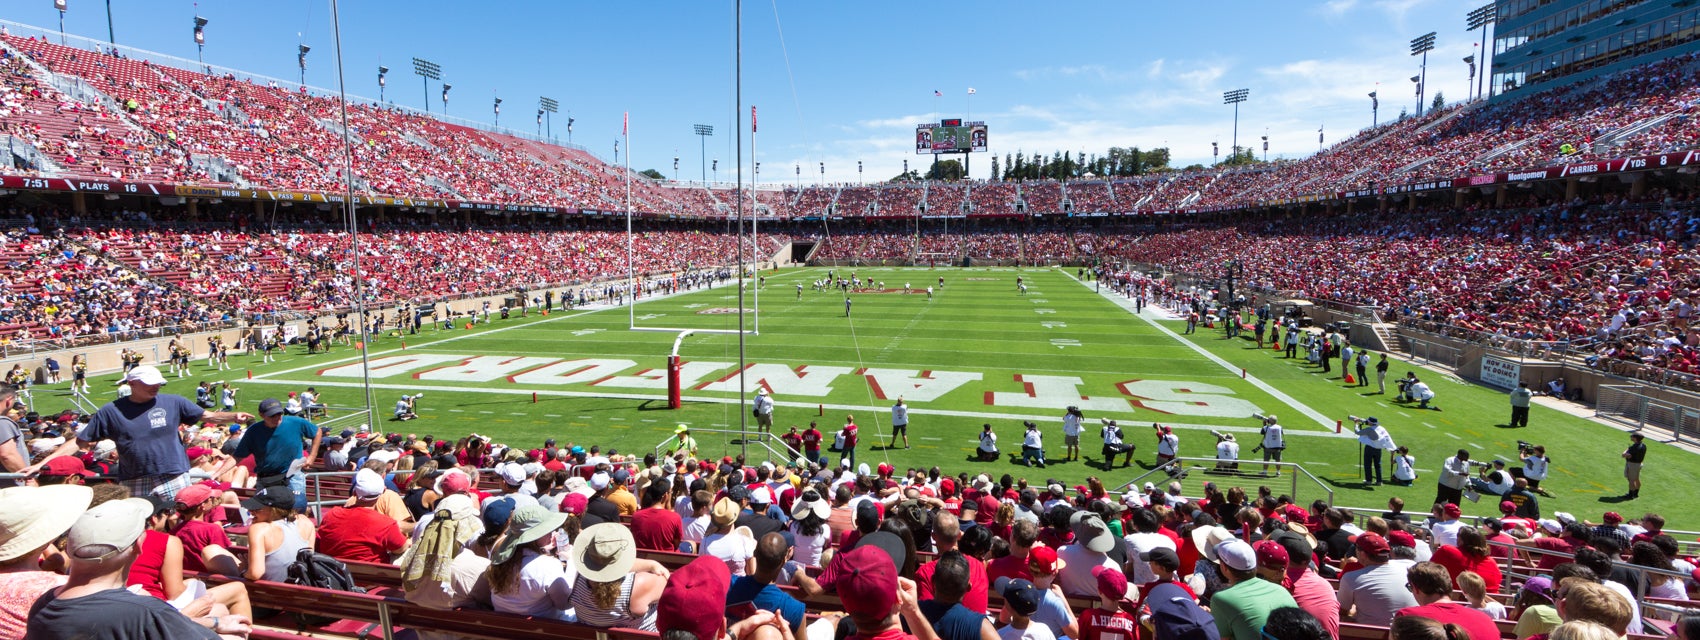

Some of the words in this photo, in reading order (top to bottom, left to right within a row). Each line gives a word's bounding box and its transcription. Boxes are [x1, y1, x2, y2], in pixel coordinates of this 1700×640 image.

[1569, 164, 1598, 174] CARRIES
[1606, 162, 1611, 171] 1
[1630, 159, 1646, 168] YDS
[1660, 155, 1667, 165] 8
[1507, 171, 1547, 181] Montgomery
[23, 178, 49, 188] 7:51
[79, 181, 109, 191] PLAYS
[124, 184, 137, 192] 16
[221, 189, 240, 197] RUSH
[1483, 364, 1491, 372] WE
[1492, 367, 1517, 379] DOING?
[1486, 359, 1500, 367] HOW
[1502, 362, 1515, 371] ARE
[315, 354, 1265, 418] STANFORD
